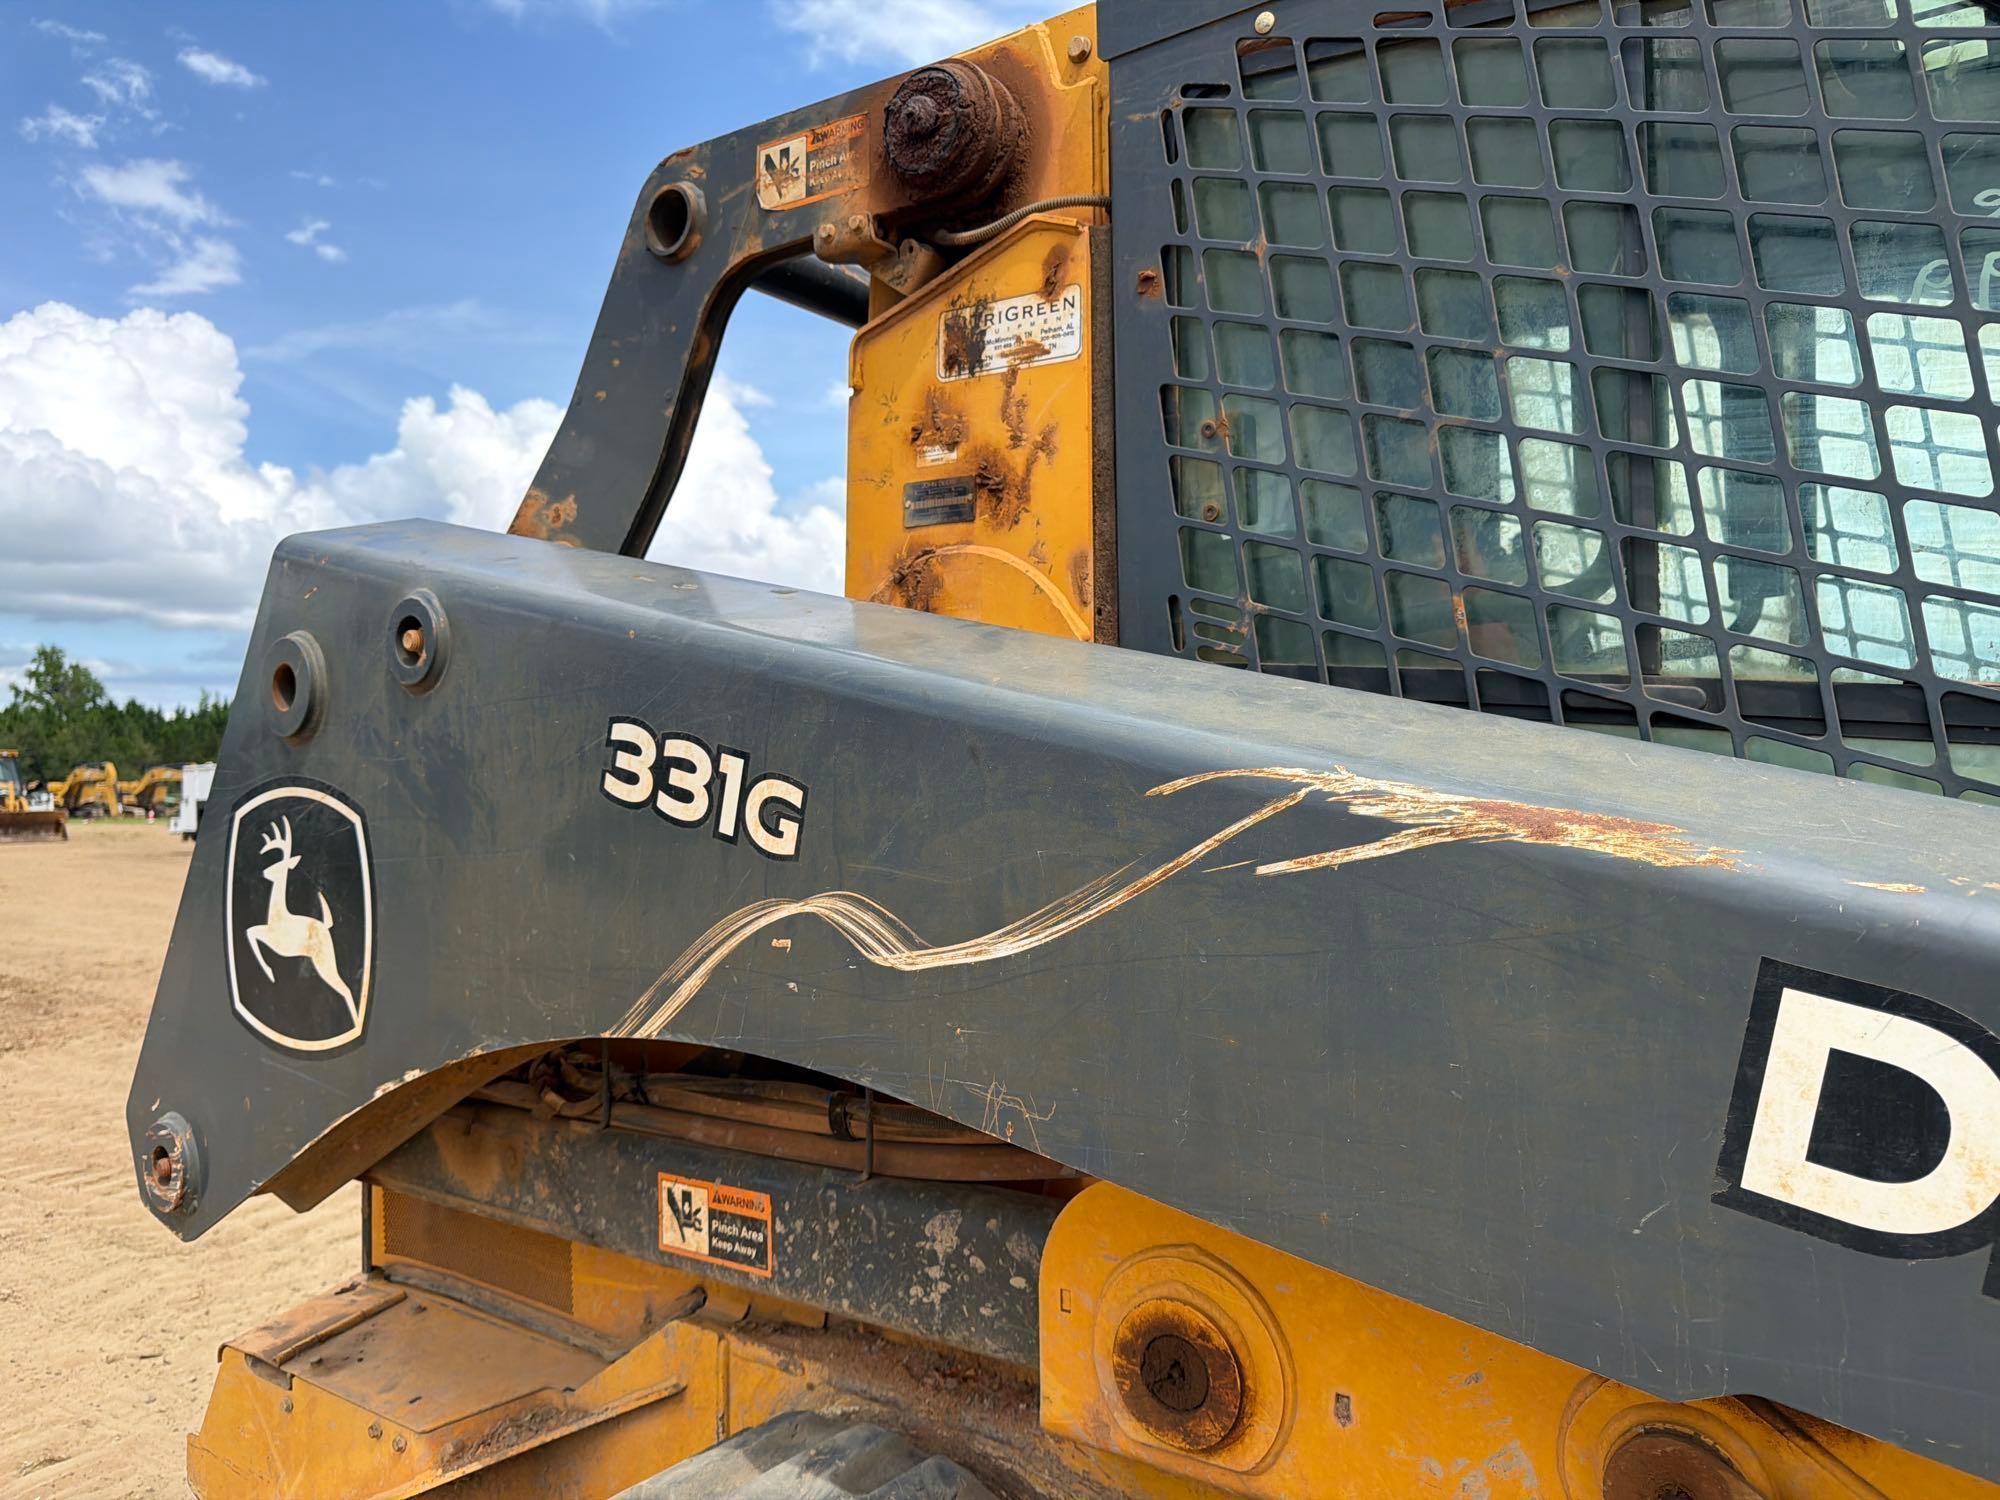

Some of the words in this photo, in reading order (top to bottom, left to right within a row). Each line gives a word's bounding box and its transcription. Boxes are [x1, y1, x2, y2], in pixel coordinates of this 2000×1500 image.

[821, 119, 864, 140] WARNING
[810, 154, 837, 171] Pinch
[971, 295, 1075, 327] RIGREEN
[1040, 326, 1064, 335] Pelham,
[603, 720, 805, 857] 331G
[722, 1193, 764, 1212] WARNING
[712, 1218, 739, 1237] Pinch
[741, 1226, 764, 1243] Area
[712, 1236, 734, 1254] Keep
[733, 1242, 756, 1259] Away
